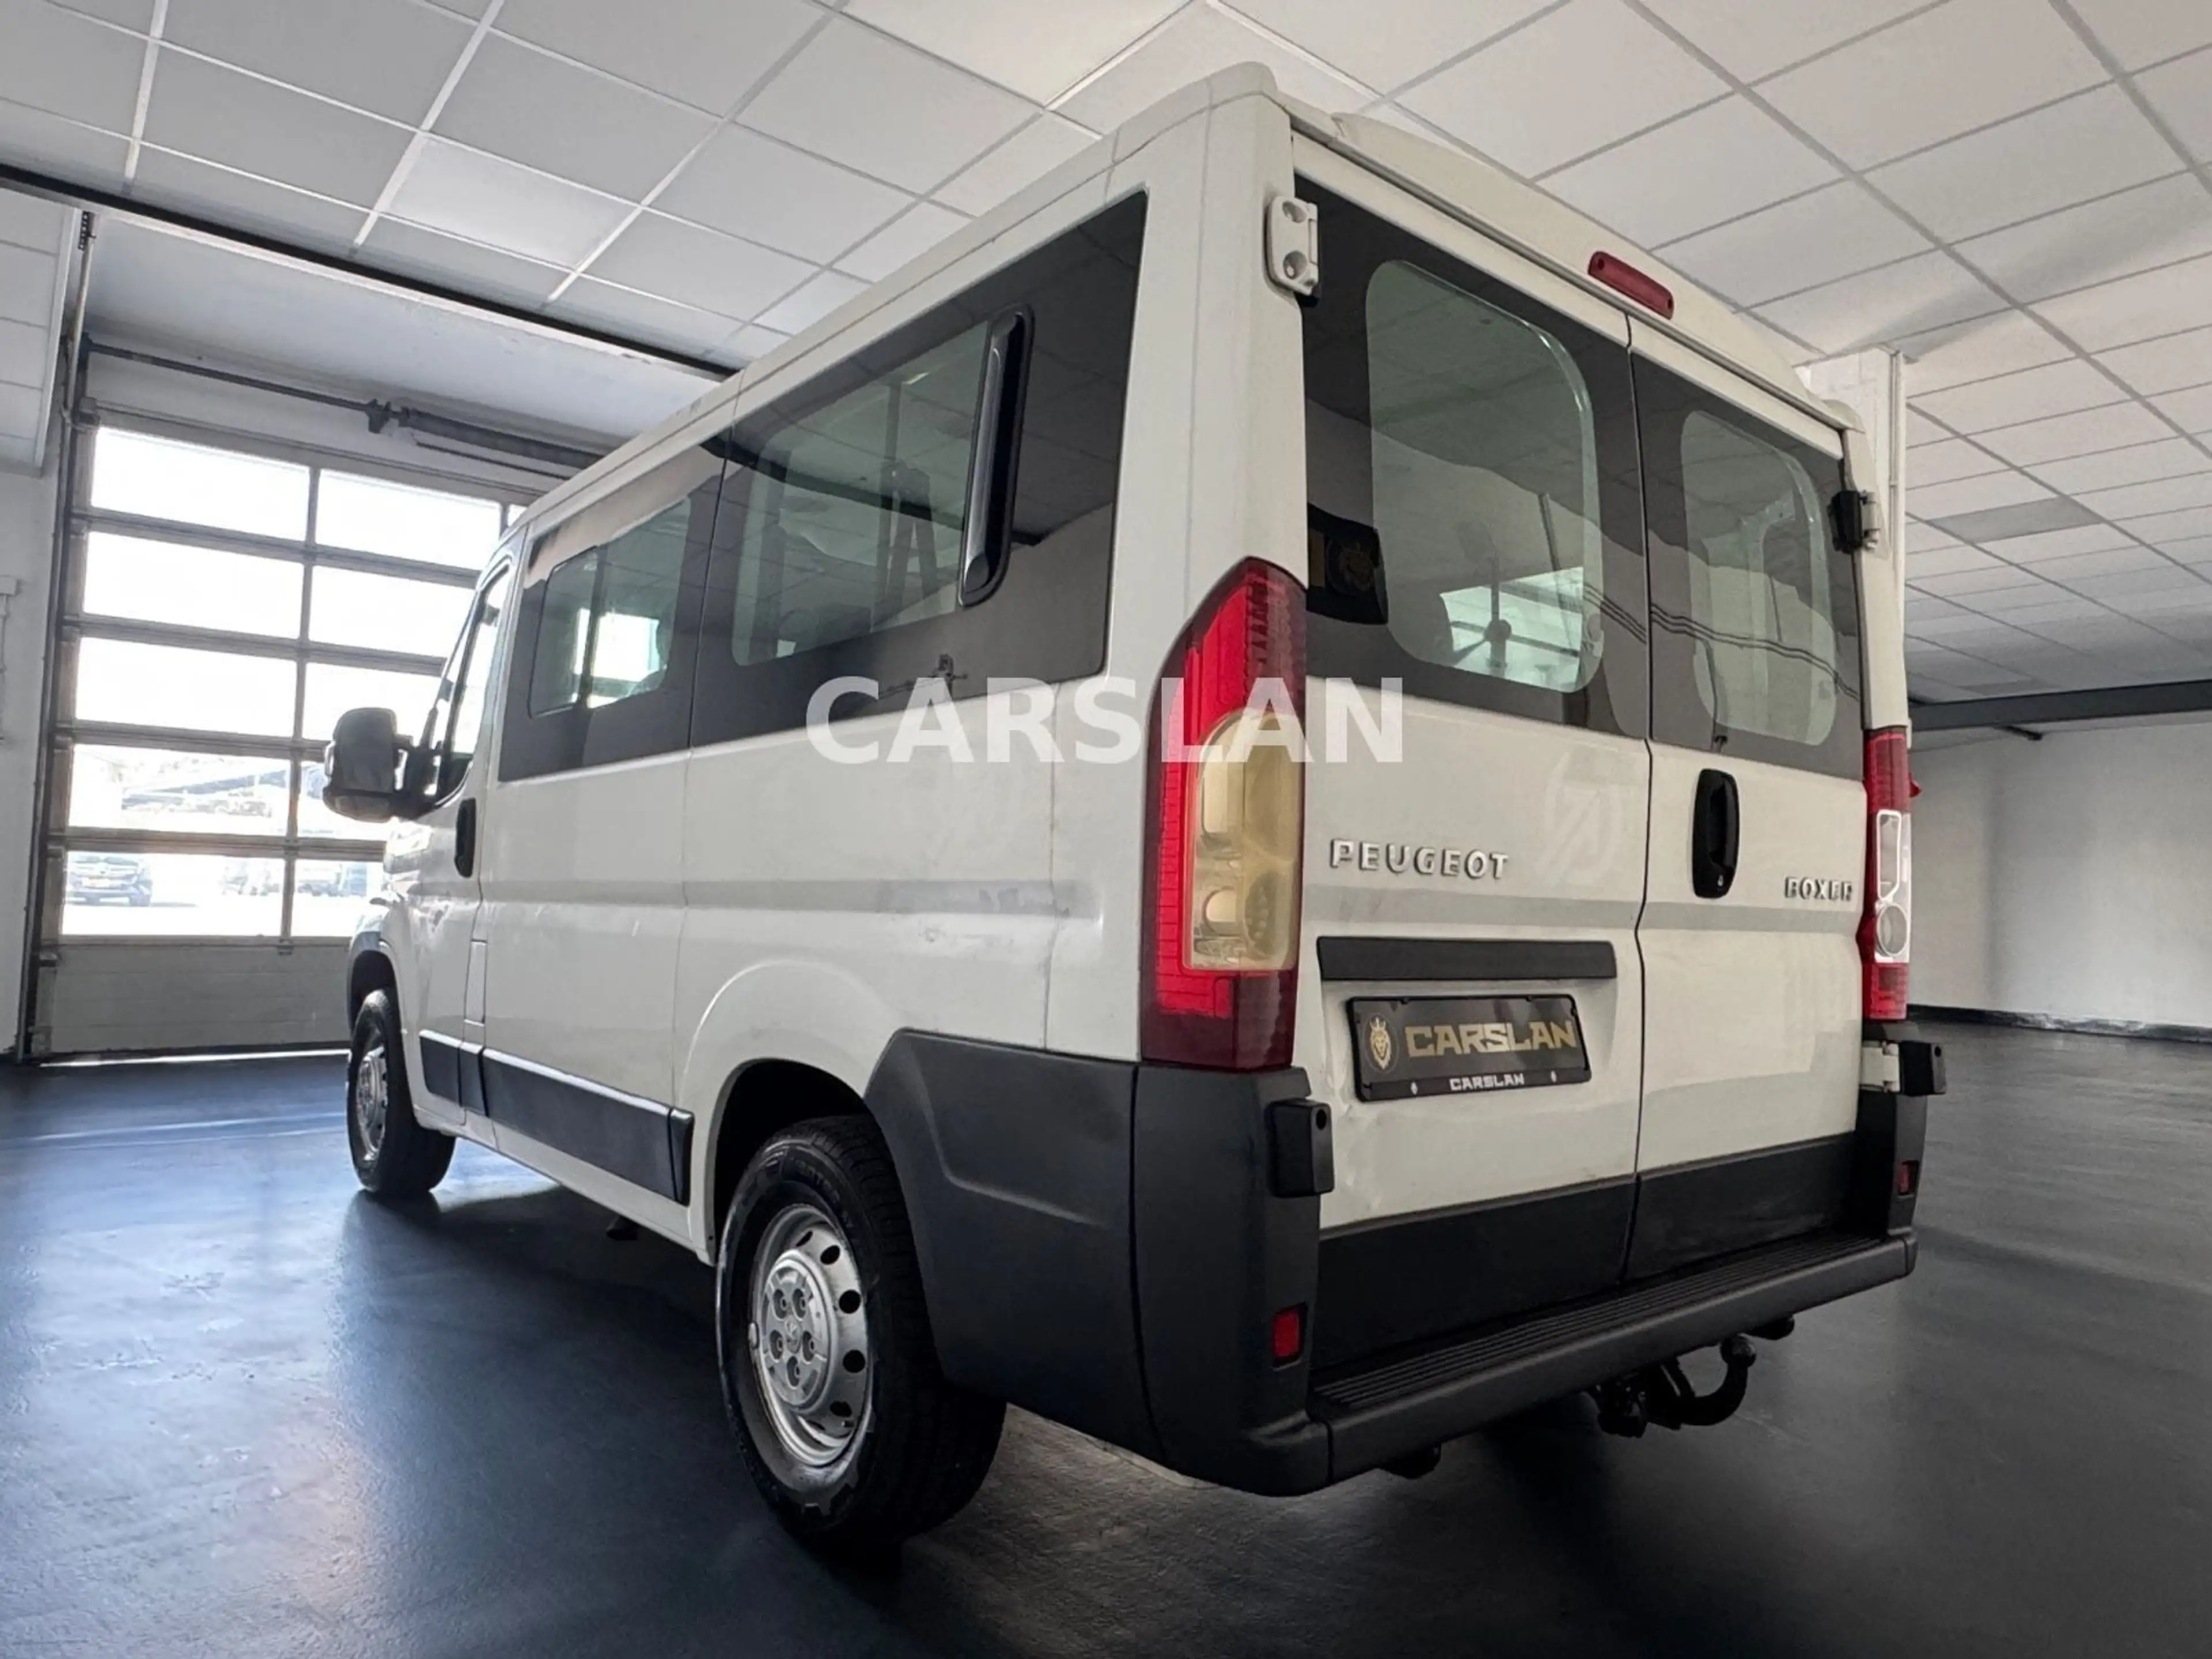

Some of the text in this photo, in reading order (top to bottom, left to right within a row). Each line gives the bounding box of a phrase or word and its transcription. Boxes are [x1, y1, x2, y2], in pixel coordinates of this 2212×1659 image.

[1331, 839, 1509, 879] PEUGEOT
[1785, 876, 1853, 901] BOXER
[1404, 1021, 1577, 1058] CARSLAN
[1449, 1073, 1525, 1090] CARSLAN
